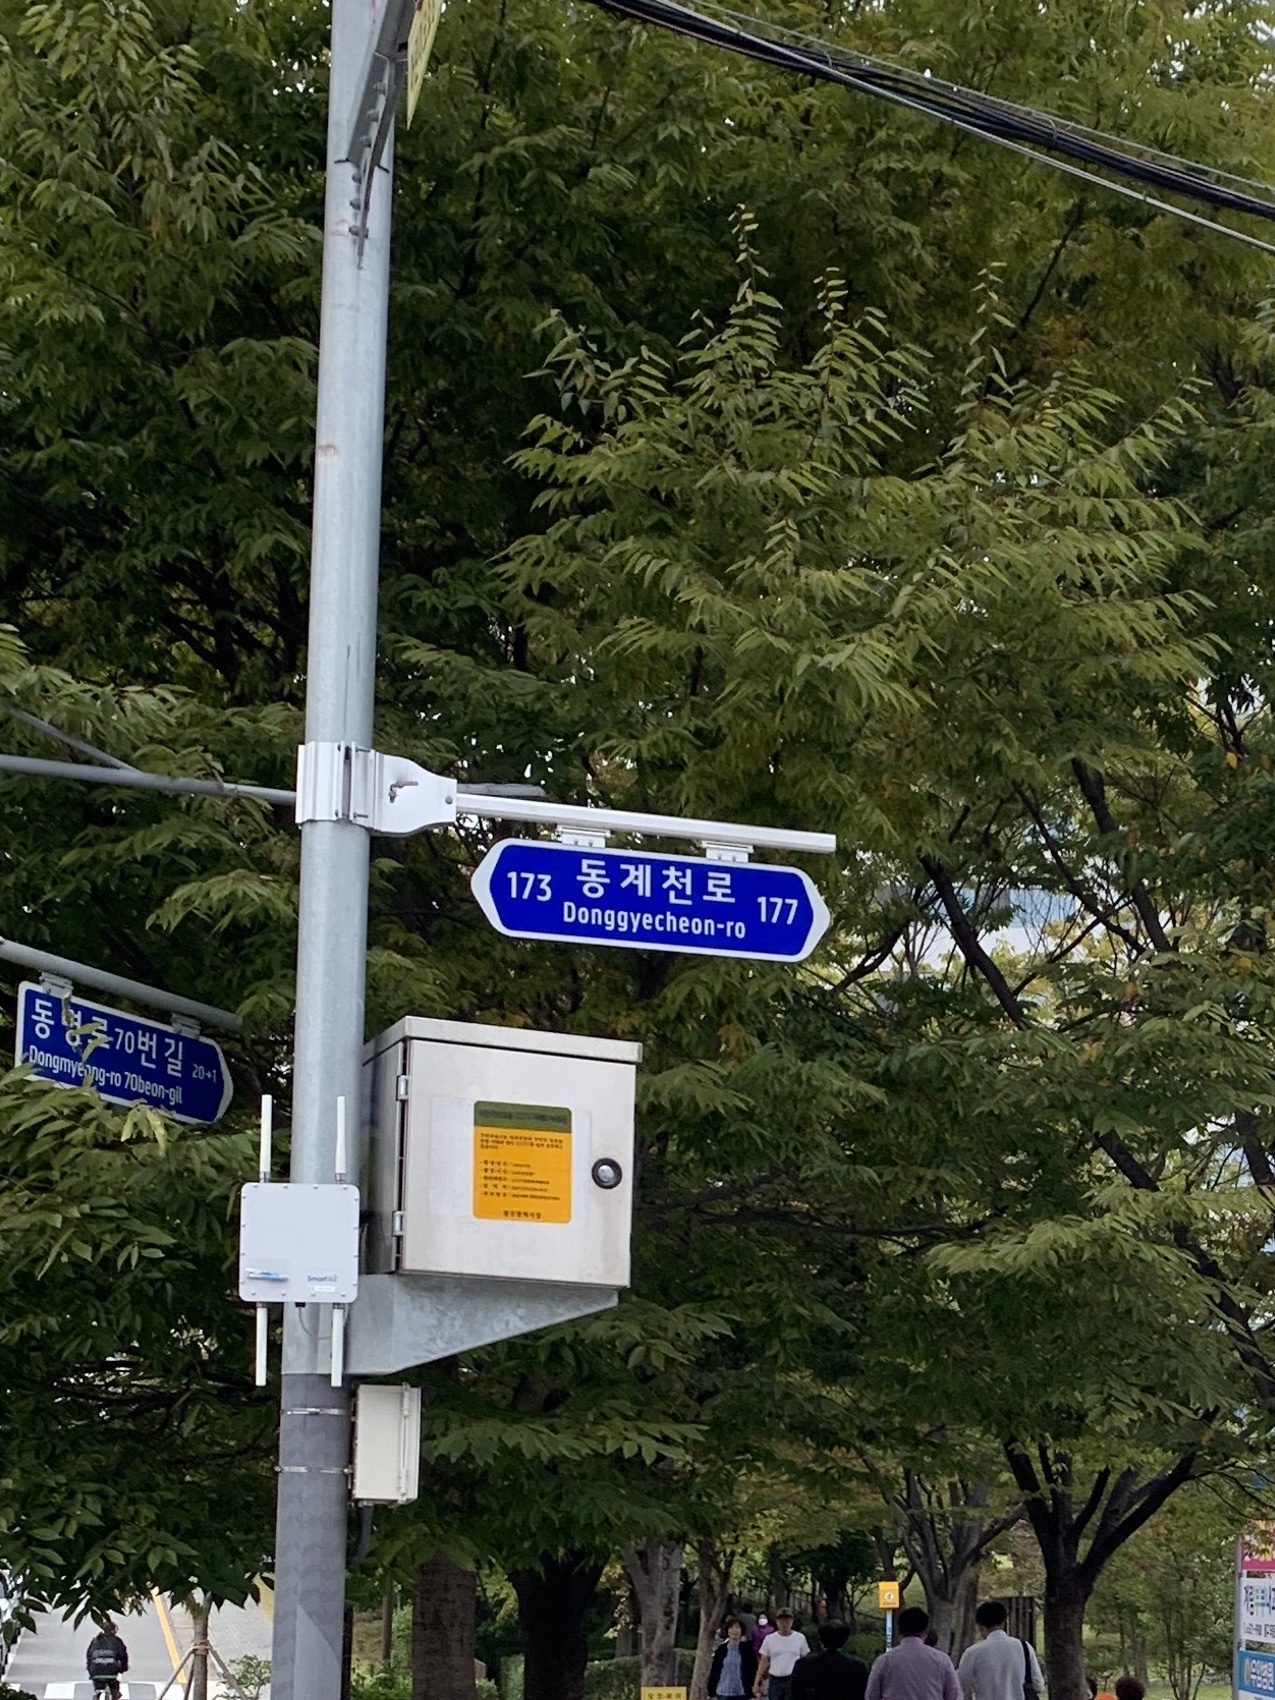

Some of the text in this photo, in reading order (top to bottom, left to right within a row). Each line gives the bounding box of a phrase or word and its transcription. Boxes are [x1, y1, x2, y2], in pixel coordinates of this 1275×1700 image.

[507, 858, 798, 925] 173 동계천로 177
[562, 901, 746, 939] Donggyecheon-ro
[124, 1071, 183, 1104] 70beon-gil
